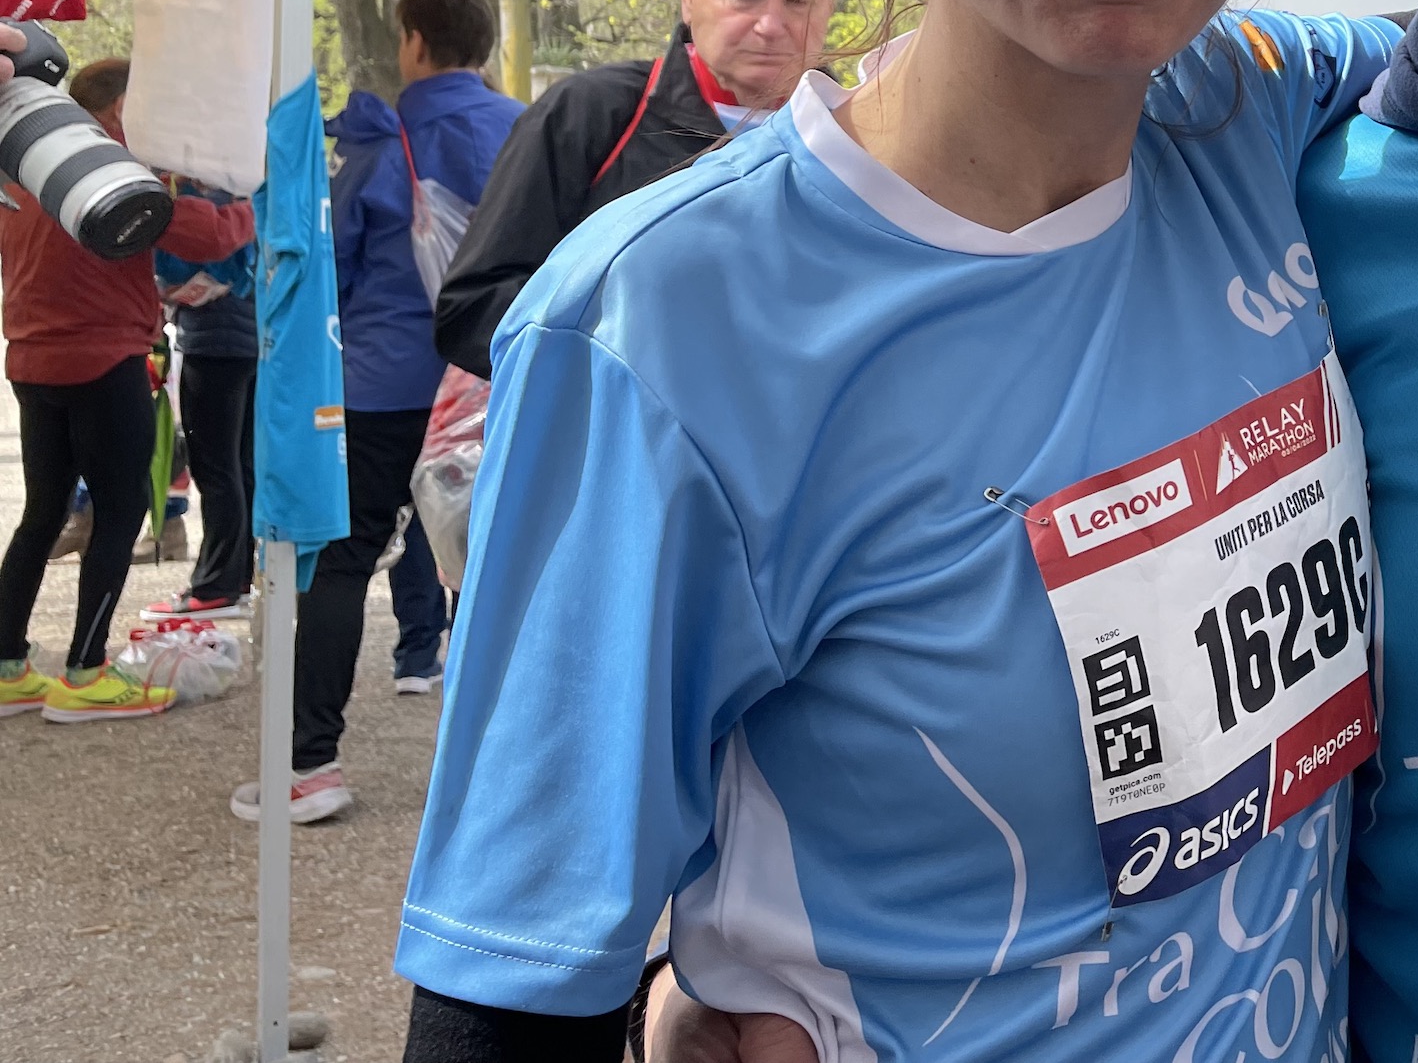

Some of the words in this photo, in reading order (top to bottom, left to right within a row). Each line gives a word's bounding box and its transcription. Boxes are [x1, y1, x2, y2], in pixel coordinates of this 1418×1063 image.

[1239, 398, 1304, 450] RELAY
[1248, 420, 1315, 466] MARATHON
[1069, 481, 1179, 539] Lenovo
[1214, 523, 1249, 561] UNITI
[1247, 510, 1273, 542] PER
[1272, 501, 1289, 528] LA
[1285, 479, 1325, 519] CORSA
[1095, 628, 1121, 645] 1629C
[1194, 515, 1368, 734] 1629C
[1295, 718, 1362, 781] Telepass
[1108, 771, 1162, 796] getpica.com
[1174, 787, 1259, 870] asics
[1031, 932, 1194, 1031] Tra
